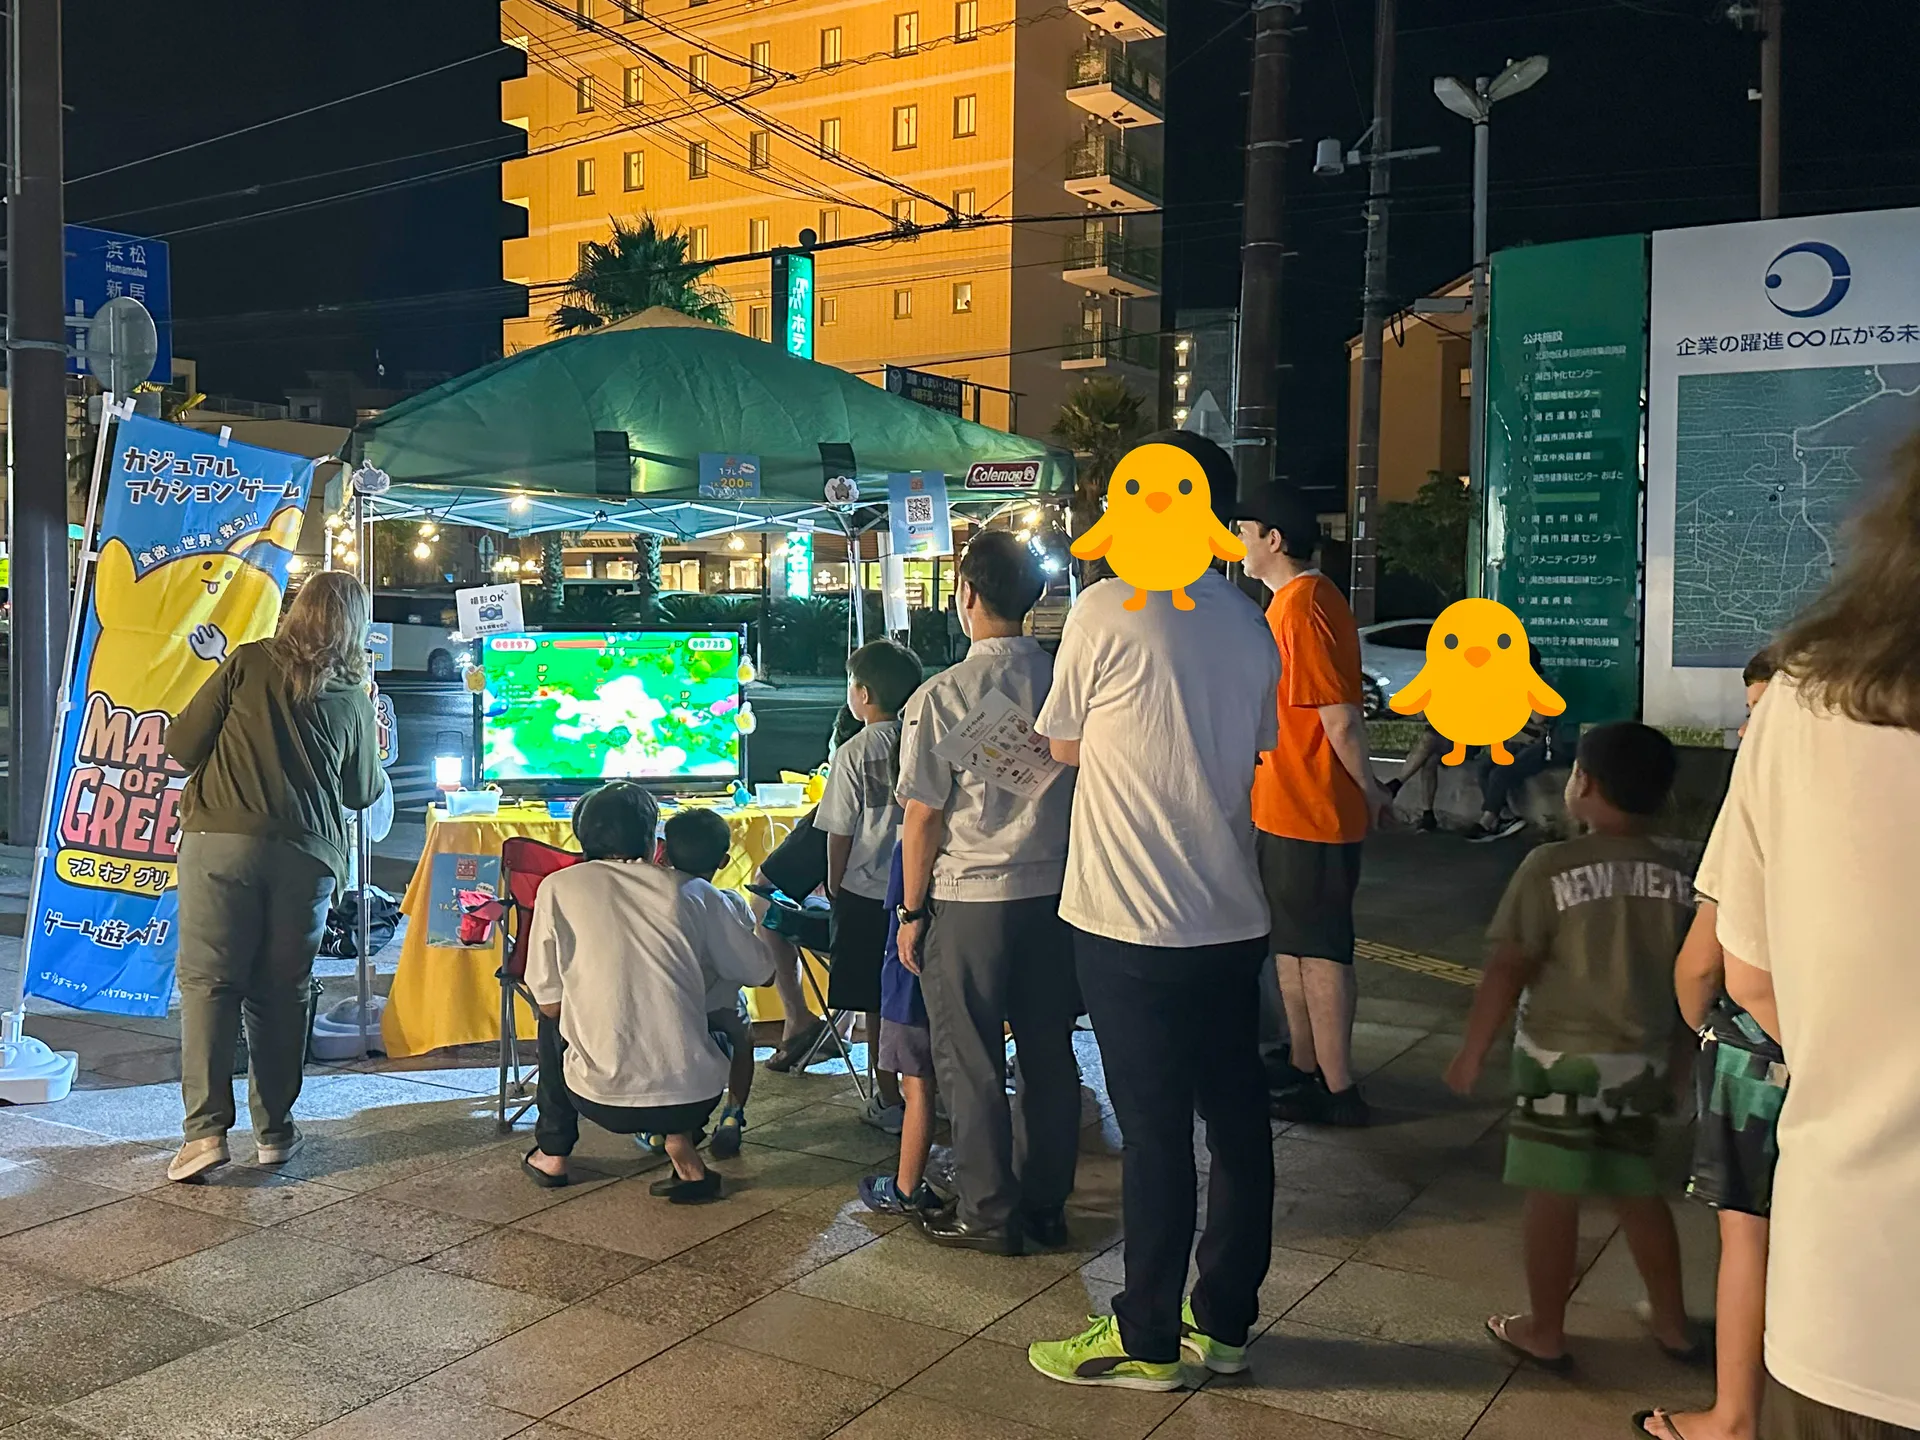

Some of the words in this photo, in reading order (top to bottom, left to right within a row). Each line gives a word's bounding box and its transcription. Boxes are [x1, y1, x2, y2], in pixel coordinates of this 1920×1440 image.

[106, 240, 146, 264] 浜松
[105, 261, 147, 278] Hamamatsu
[106, 279, 146, 302] 新居
[1523, 331, 1563, 344] 公共施設
[1534, 408, 1601, 421] 湖西運動公園
[123, 446, 240, 479] カジュアル
[1533, 451, 1591, 462] 市立中央図書館
[972, 466, 1023, 482] Coleman
[1531, 513, 1598, 524] 湖西市役所
[1530, 533, 1622, 543] 湖西市環境センター
[1530, 555, 1597, 564] アメニティプラザ
[1530, 596, 1573, 605] 湖西病院
[80, 696, 186, 772] MA
[123, 768, 165, 794] OF
[62, 766, 182, 856] GREE
[1551, 862, 1614, 911] NEW
